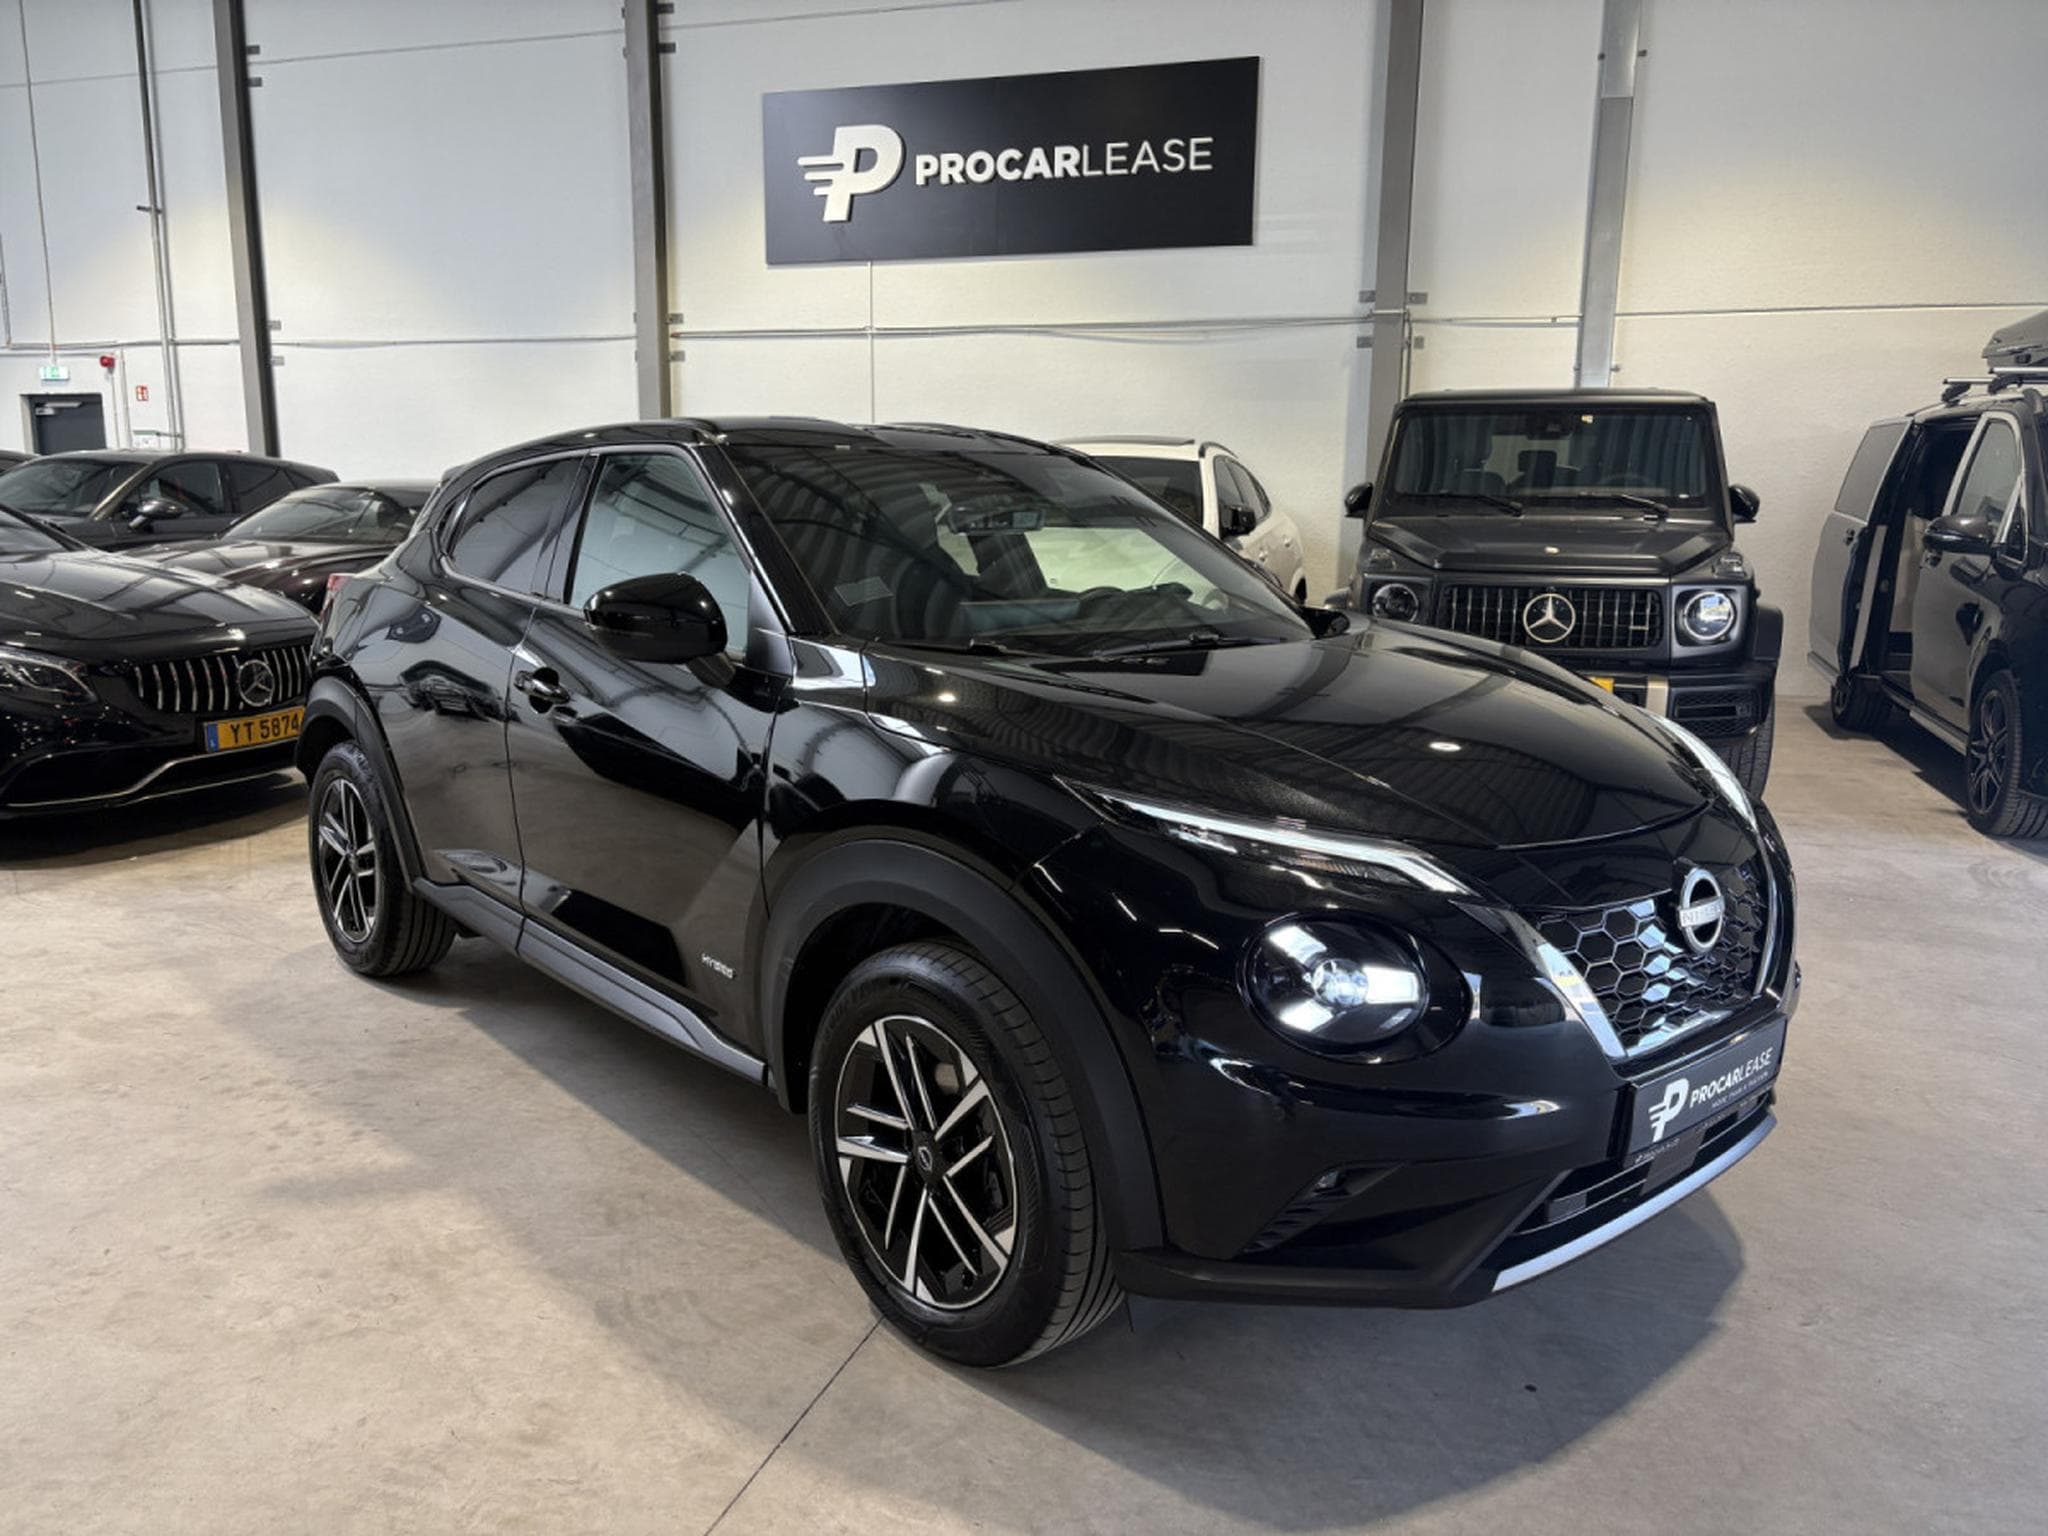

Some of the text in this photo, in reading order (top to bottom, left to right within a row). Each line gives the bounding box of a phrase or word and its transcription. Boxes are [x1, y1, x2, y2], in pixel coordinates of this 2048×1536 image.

[915, 137, 1214, 186] PROCARLEASE
[230, 713, 299, 745] YT 5874
[1688, 1047, 1774, 1108] PROCARLEASE
